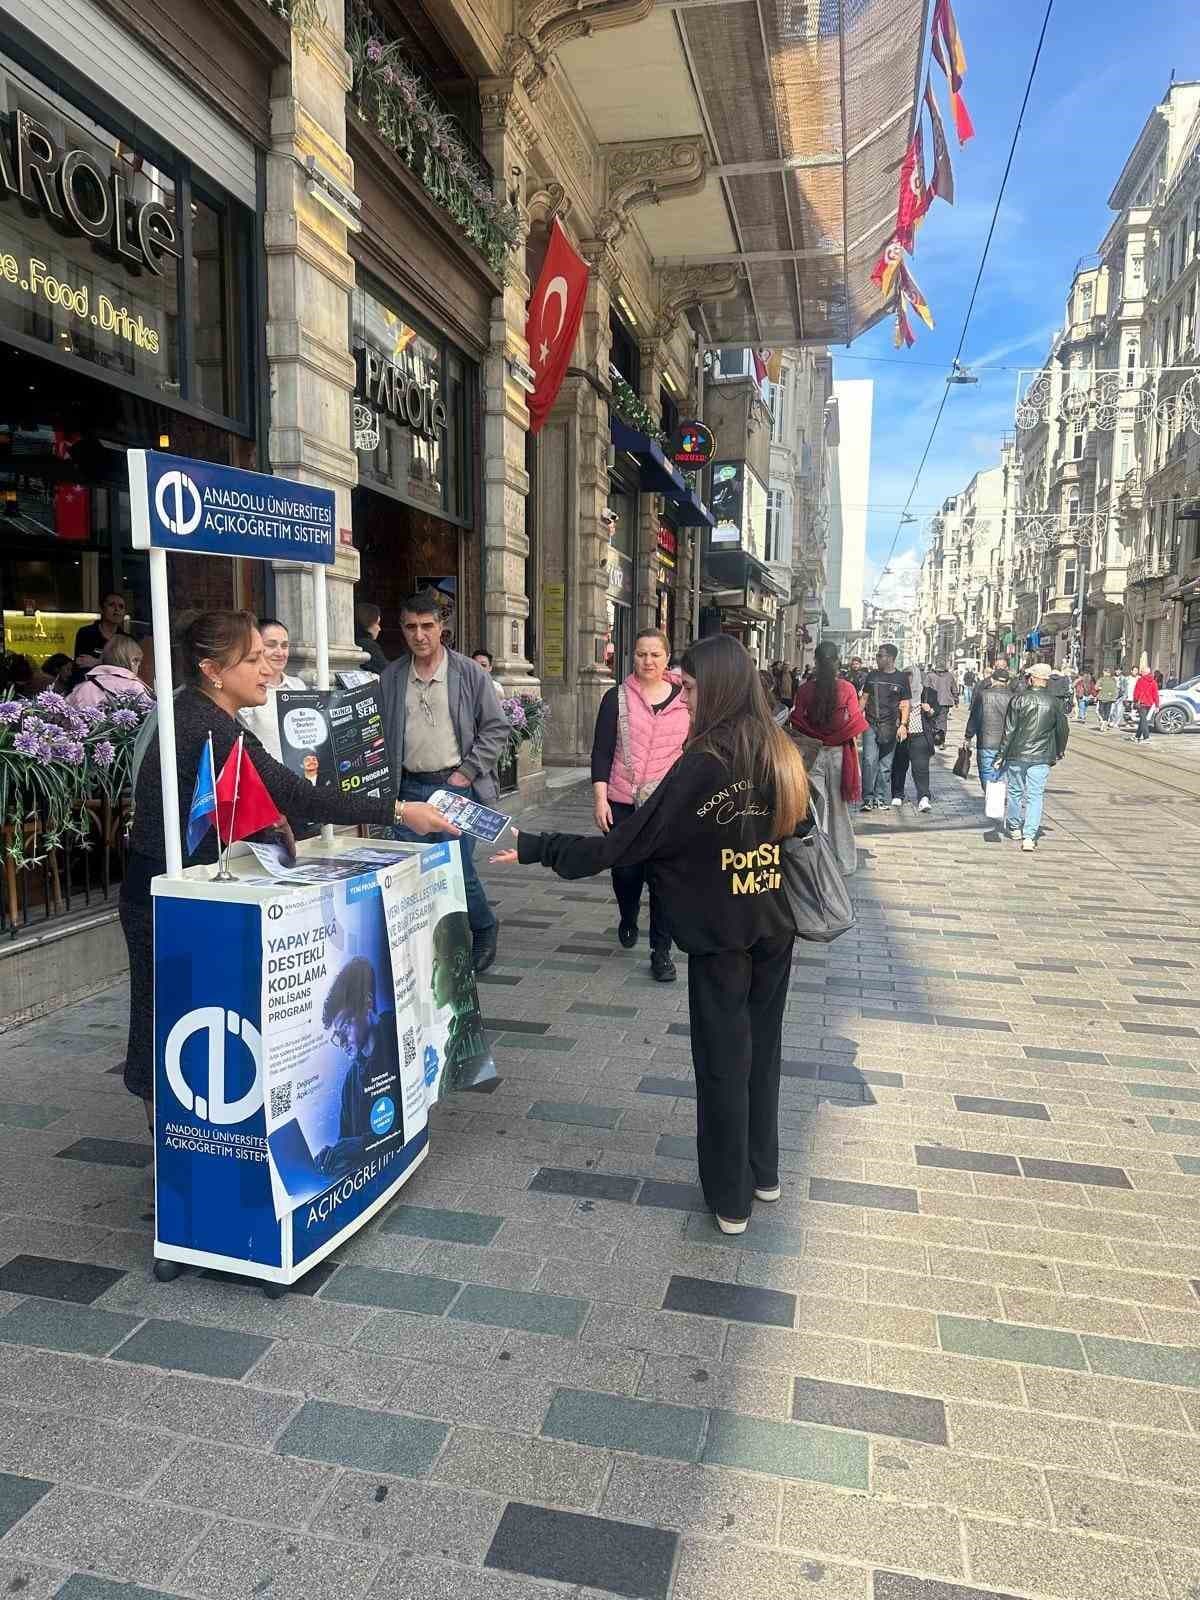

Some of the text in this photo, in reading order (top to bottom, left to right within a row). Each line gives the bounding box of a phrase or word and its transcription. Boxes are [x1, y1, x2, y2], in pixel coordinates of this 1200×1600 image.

[203, 486, 332, 523] ANADOLU ÜNİVERSİTESİ
[204, 512, 332, 545] AÇIKÖĞRETİM SİSTEMİ
[341, 766, 389, 792] 50 PROGRAM
[697, 788, 730, 818] SOON
[267, 918, 337, 954] YAPAY ZEKÂ
[268, 941, 325, 974] DESTEKLİ
[268, 964, 327, 994] KODLAMA
[268, 987, 312, 1008] ÖNLİSANS
[268, 1000, 313, 1023] PROGRAMI
[165, 1122, 210, 1139] ANADOLU
[165, 1136, 233, 1158] AÇIKÖĞRETİM
